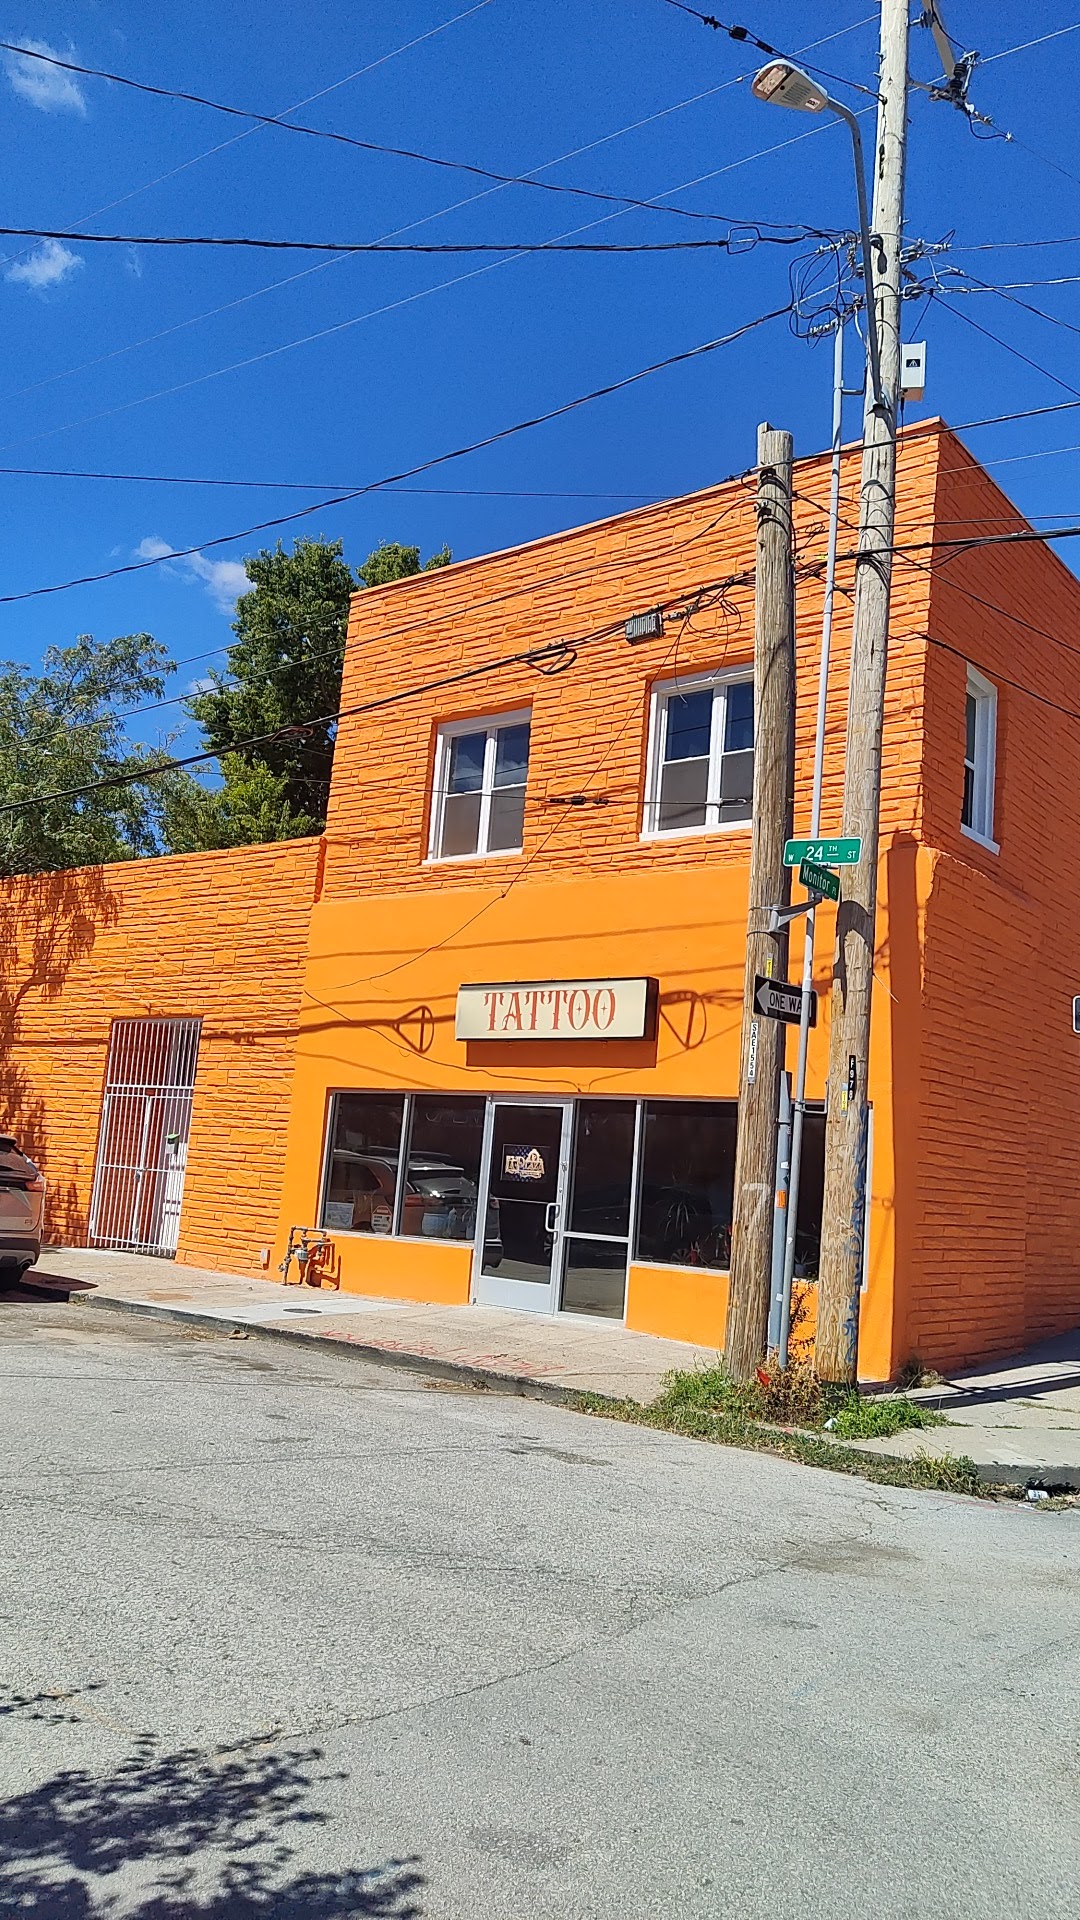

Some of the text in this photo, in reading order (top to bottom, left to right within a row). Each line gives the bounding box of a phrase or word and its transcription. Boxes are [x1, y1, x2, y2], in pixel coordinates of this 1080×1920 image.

[788, 853, 794, 862] W
[847, 850, 857, 859] ST
[802, 864, 831, 891] Monitor
[484, 989, 616, 1031] TATTOO
[769, 992, 786, 1010] ONE
